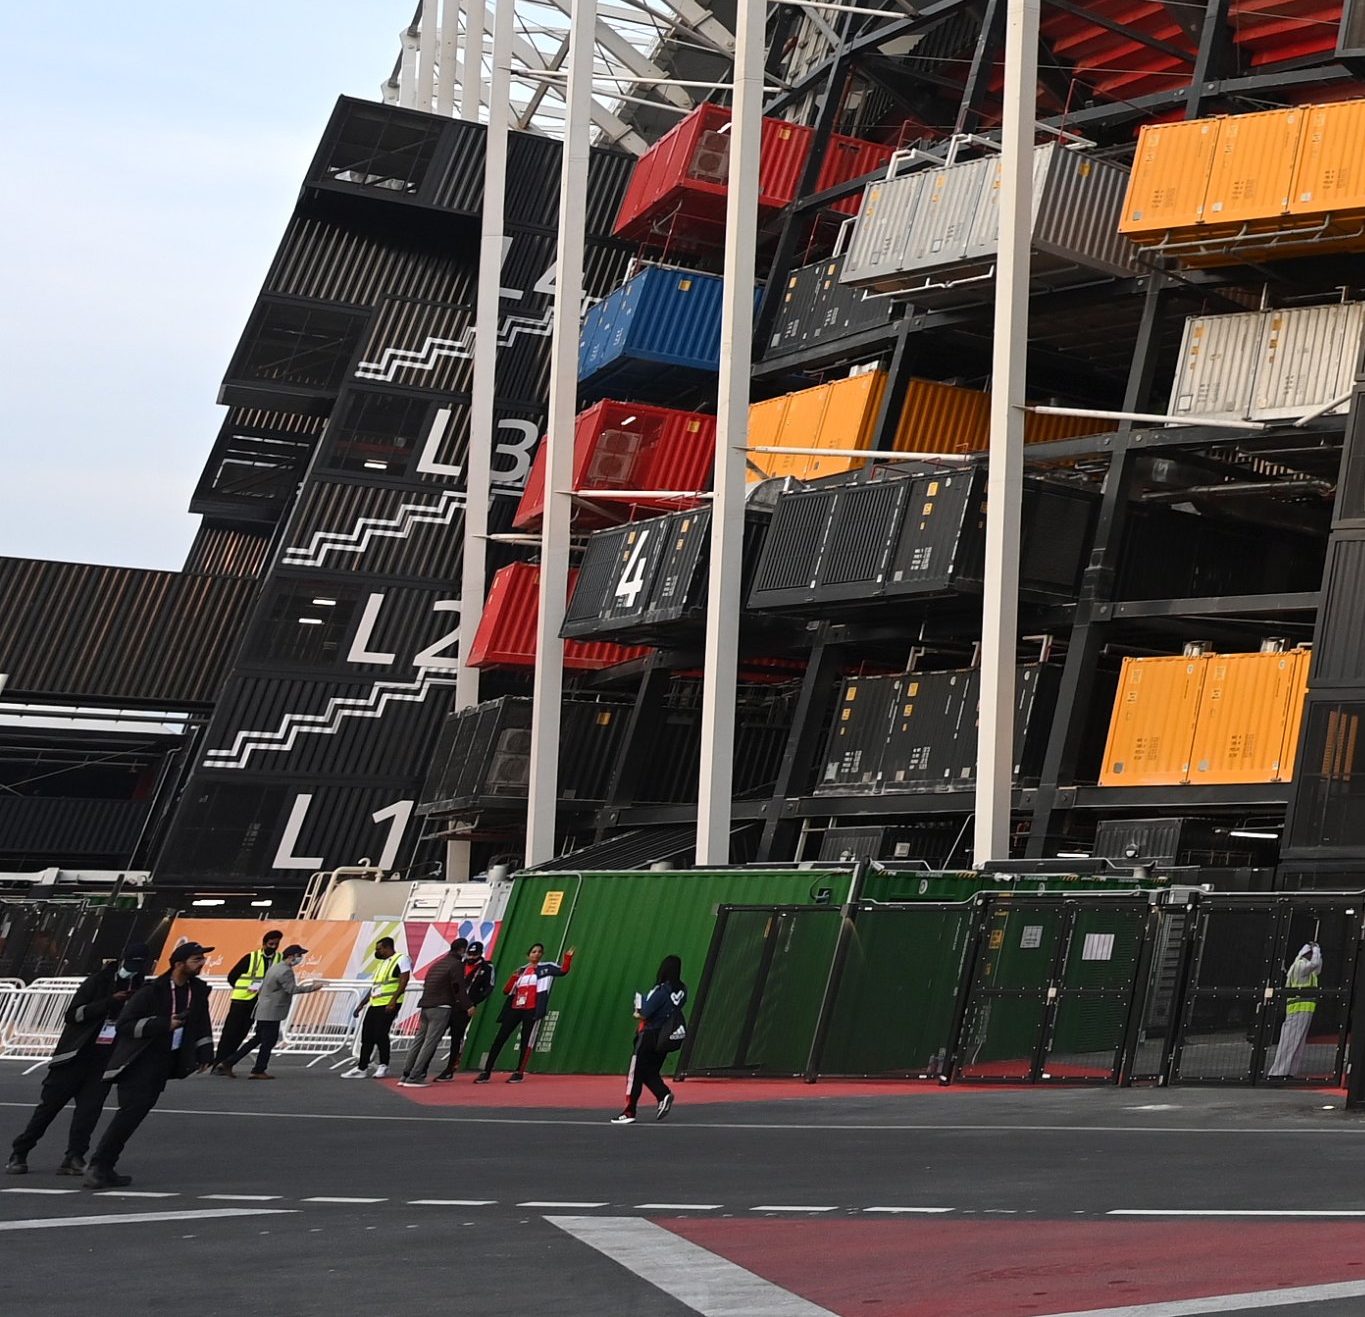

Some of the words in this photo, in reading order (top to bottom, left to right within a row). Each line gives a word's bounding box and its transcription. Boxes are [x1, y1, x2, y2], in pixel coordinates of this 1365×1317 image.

[415, 408, 539, 483] L3
[615, 530, 649, 608] 4
[346, 592, 461, 668] L2
[272, 793, 414, 870] L1
